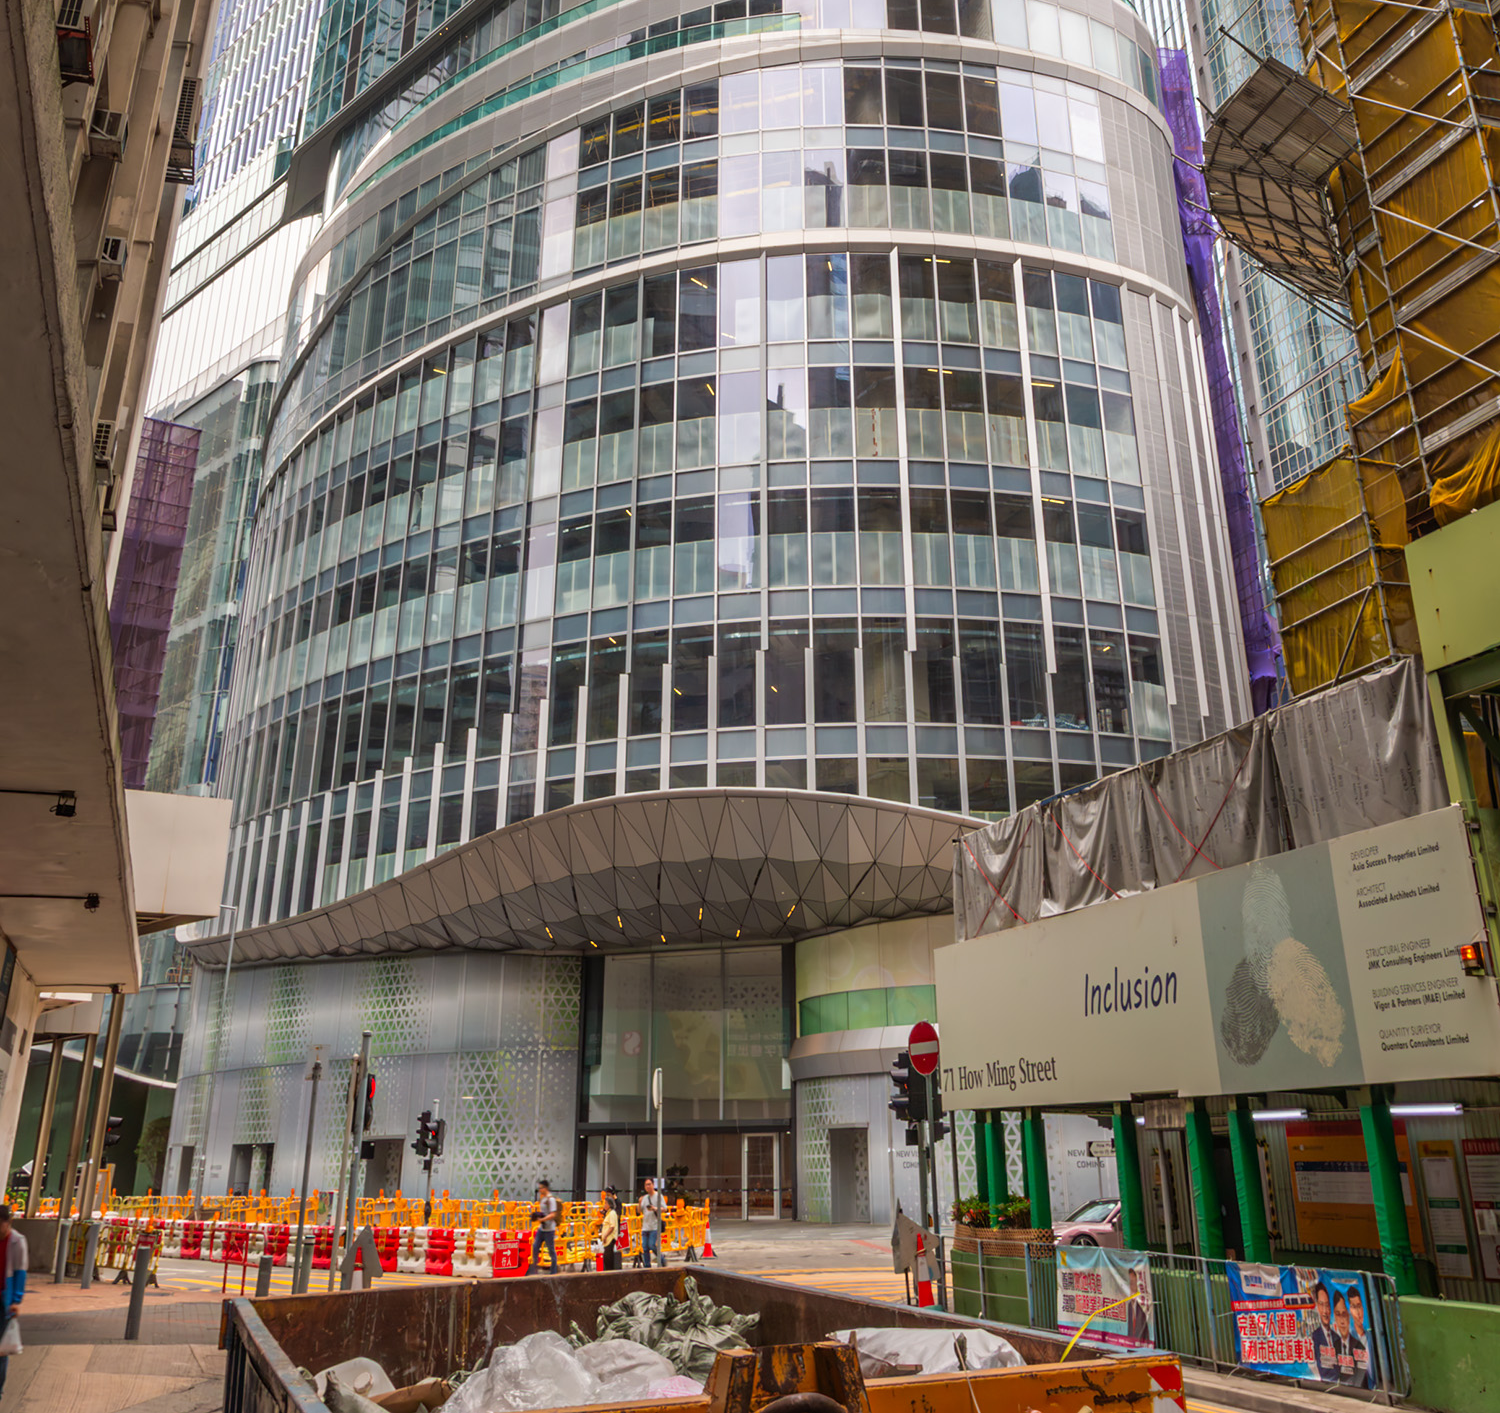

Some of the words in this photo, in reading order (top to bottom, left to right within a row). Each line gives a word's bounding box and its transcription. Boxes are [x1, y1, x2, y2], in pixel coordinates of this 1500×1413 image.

[1350, 845, 1379, 861] DEVELOPER
[1352, 863, 1365, 872] Asia
[1365, 858, 1387, 869] Success
[1388, 850, 1417, 863] Properties
[1417, 841, 1440, 856] Limited
[1356, 882, 1386, 897] ARCHITECT
[1358, 895, 1389, 909] Associated
[1389, 888, 1417, 902] Architects
[1417, 882, 1440, 896] Limited
[1366, 943, 1401, 959] STRUCTURAL
[1401, 938, 1431, 953] ENGINEER
[1368, 959, 1381, 970] JMK
[1381, 955, 1413, 968] Consulting
[1413, 950, 1443, 964] Engineers
[1084, 966, 1177, 1017] Inclusion
[1372, 985, 1400, 999] BUILDING
[1400, 981, 1426, 994] SERVICES
[1427, 977, 1459, 990] ENGINEER
[1374, 999, 1390, 1012] Vigor
[1391, 998, 1396, 1008] &
[1397, 996, 1422, 1007] Partners
[1422, 992, 1442, 1006] (M&E)
[1442, 988, 1466, 1001] Limited
[1379, 1027, 1410, 1040] QUANTITY
[1411, 1023, 1442, 1036] SURVEYOR
[1409, 1036, 1445, 1049] Consultants
[1445, 1032, 1470, 1045] Limited
[943, 1068, 954, 1092] 71
[958, 1066, 983, 1091] How
[986, 1060, 1017, 1091] Ming
[1019, 1057, 1058, 1084] Street
[1067, 1149, 1086, 1157] NEW
[1076, 1160, 1105, 1168] COMING
[1238, 1313, 1297, 1336] 完善行人通道
